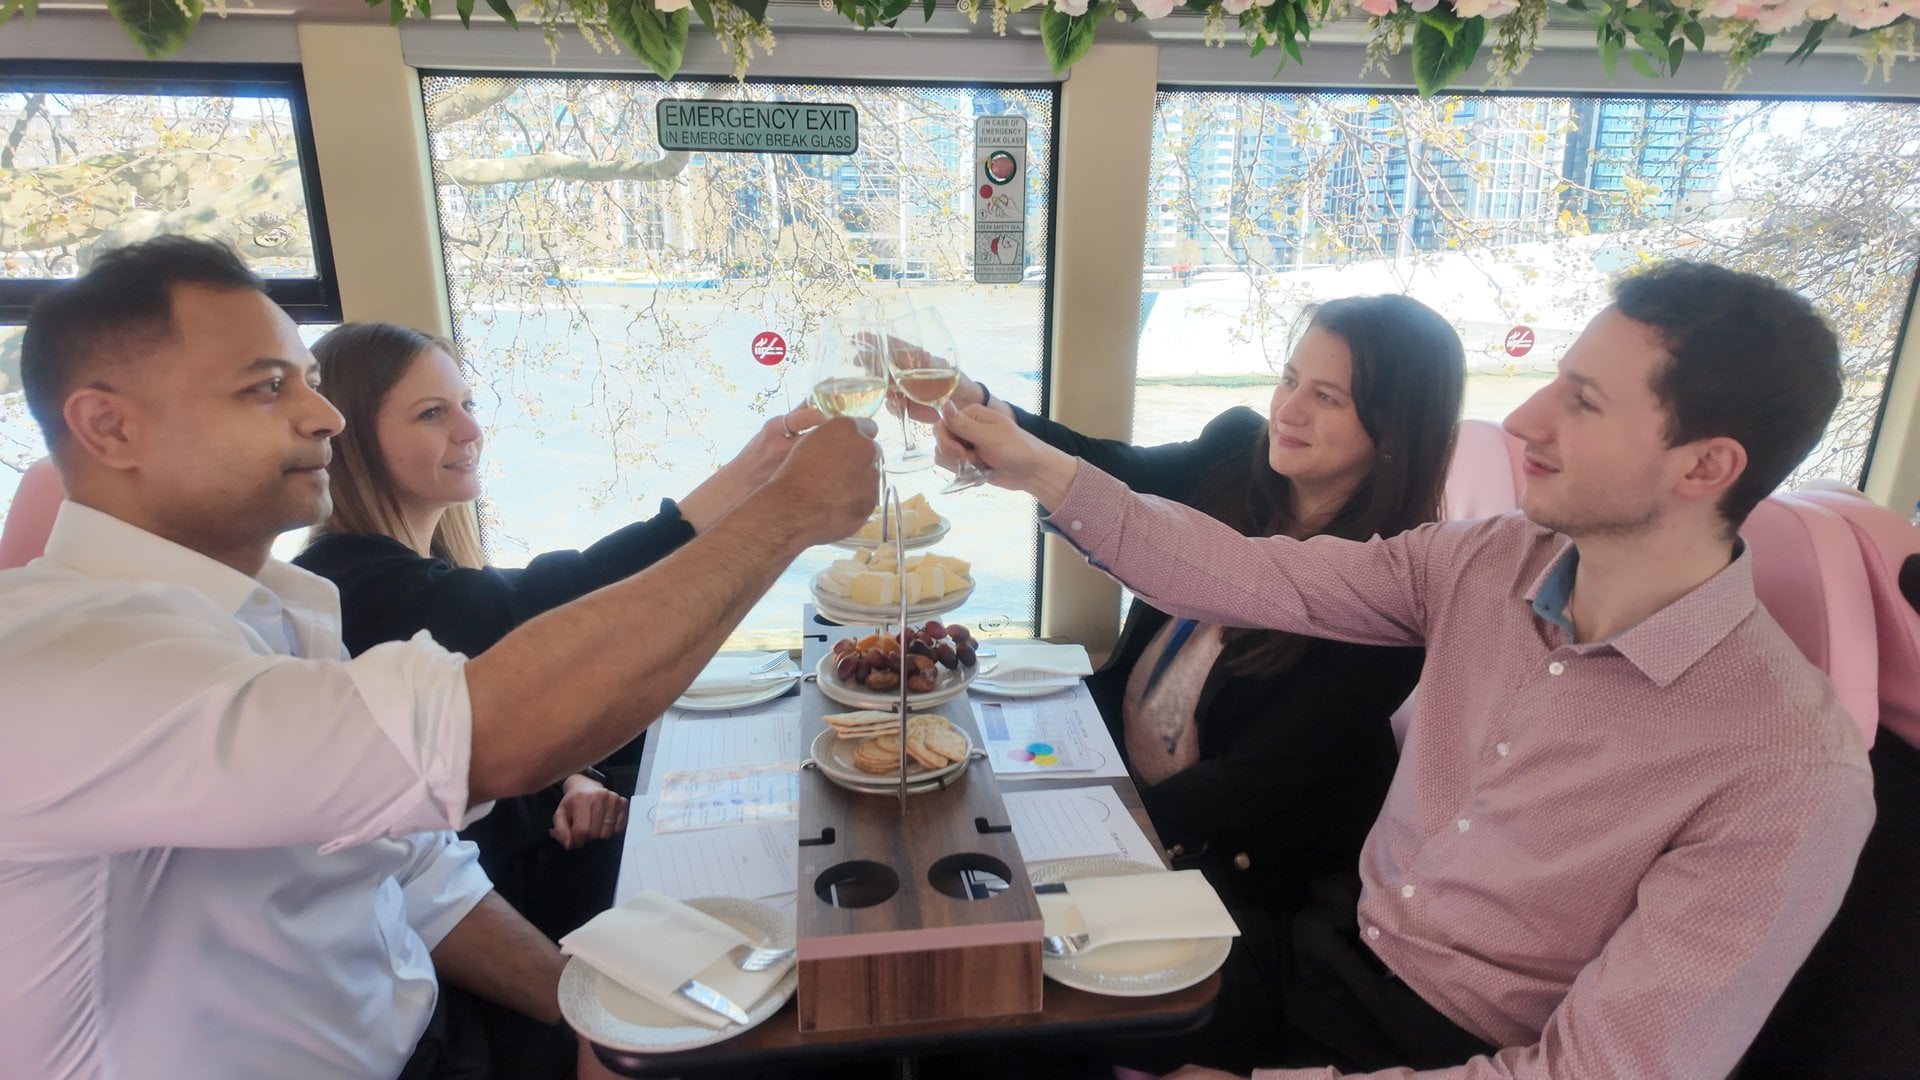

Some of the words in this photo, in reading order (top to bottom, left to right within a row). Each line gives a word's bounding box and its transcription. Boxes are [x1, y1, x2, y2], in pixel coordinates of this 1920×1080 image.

[665, 105, 799, 129] EMERGENCY
[806, 109, 851, 131] EXIT
[665, 131, 678, 144] IN
[682, 132, 763, 146] EMERGENCY
[766, 133, 808, 147] BREAK
[811, 134, 852, 149] GLASS
